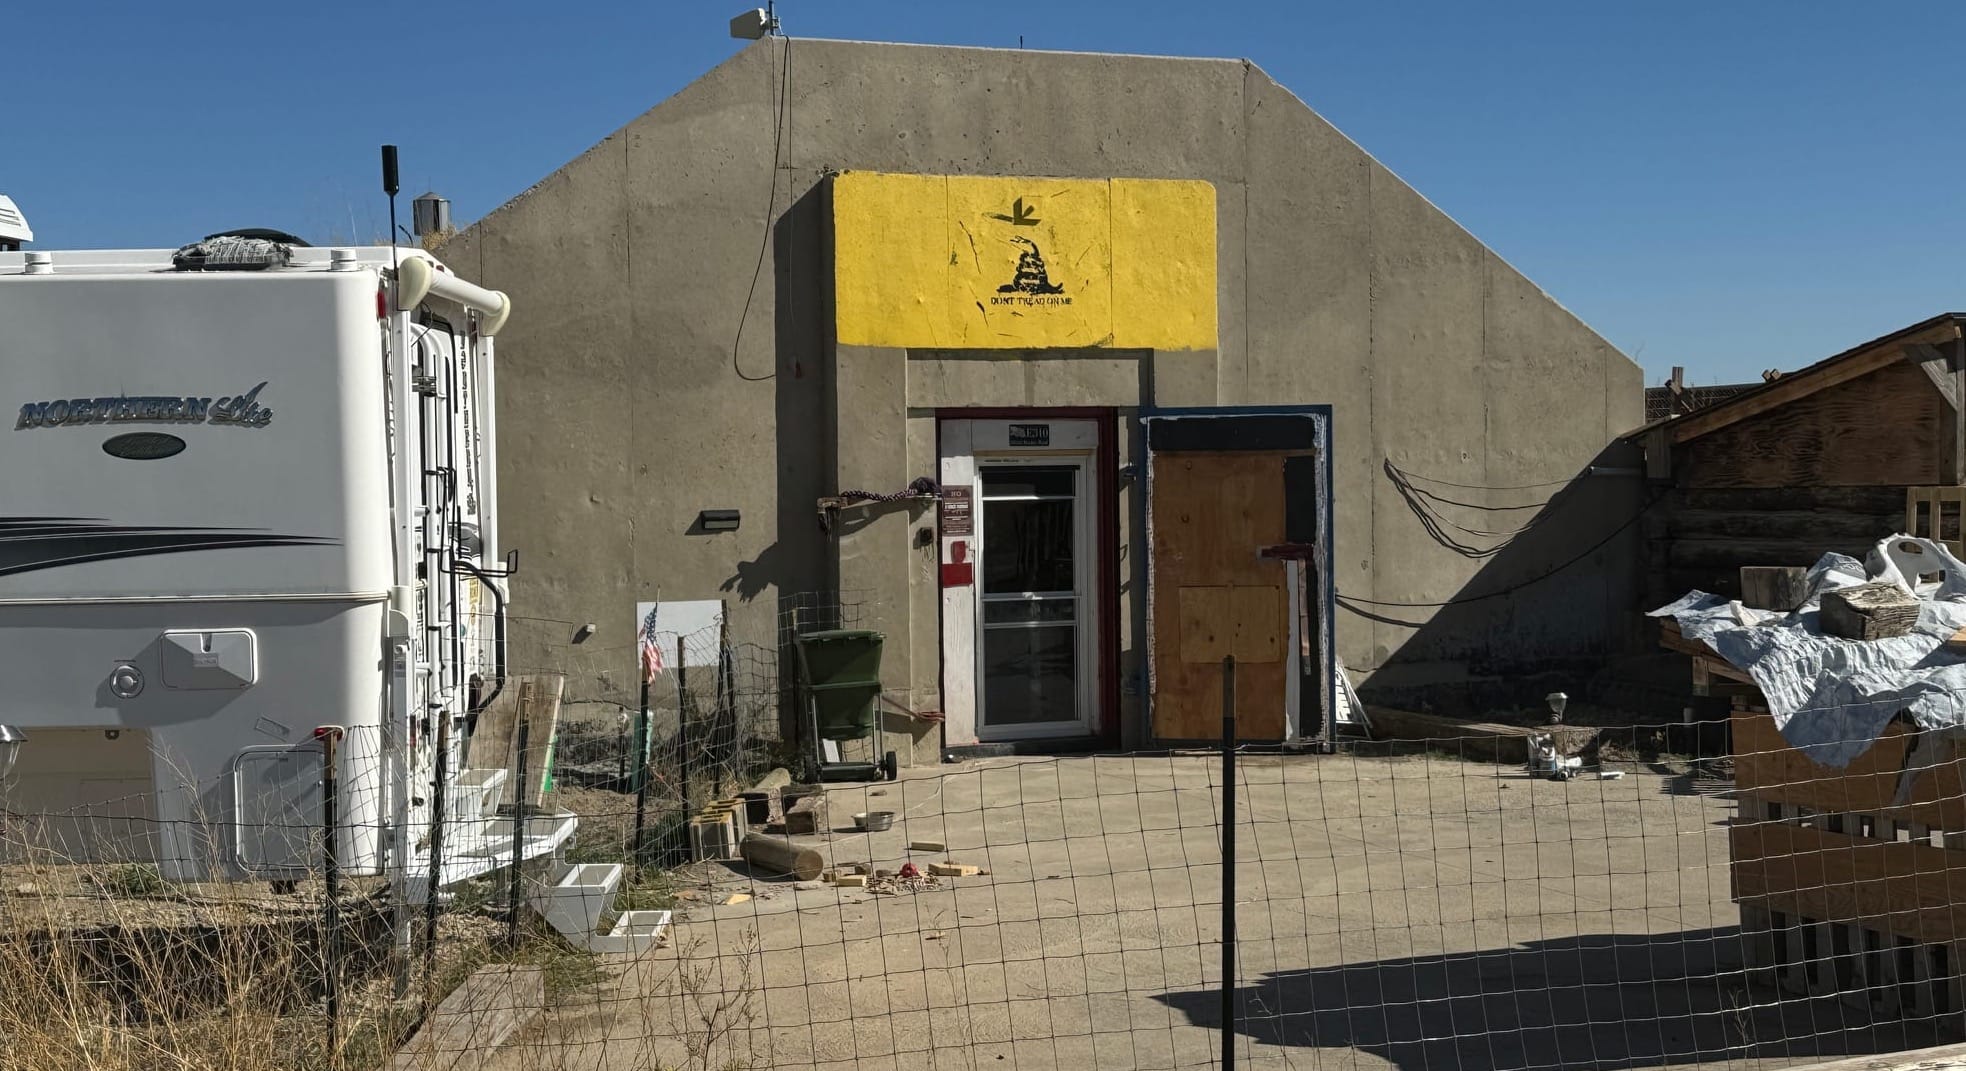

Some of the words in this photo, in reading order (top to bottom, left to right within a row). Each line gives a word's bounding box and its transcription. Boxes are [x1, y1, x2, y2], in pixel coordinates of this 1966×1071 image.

[991, 297, 1014, 305] DONT
[1017, 297, 1045, 306] TREAD
[1047, 297, 1060, 305] ON
[1061, 297, 1072, 305] ME
[15, 396, 211, 431] NORTHERN
